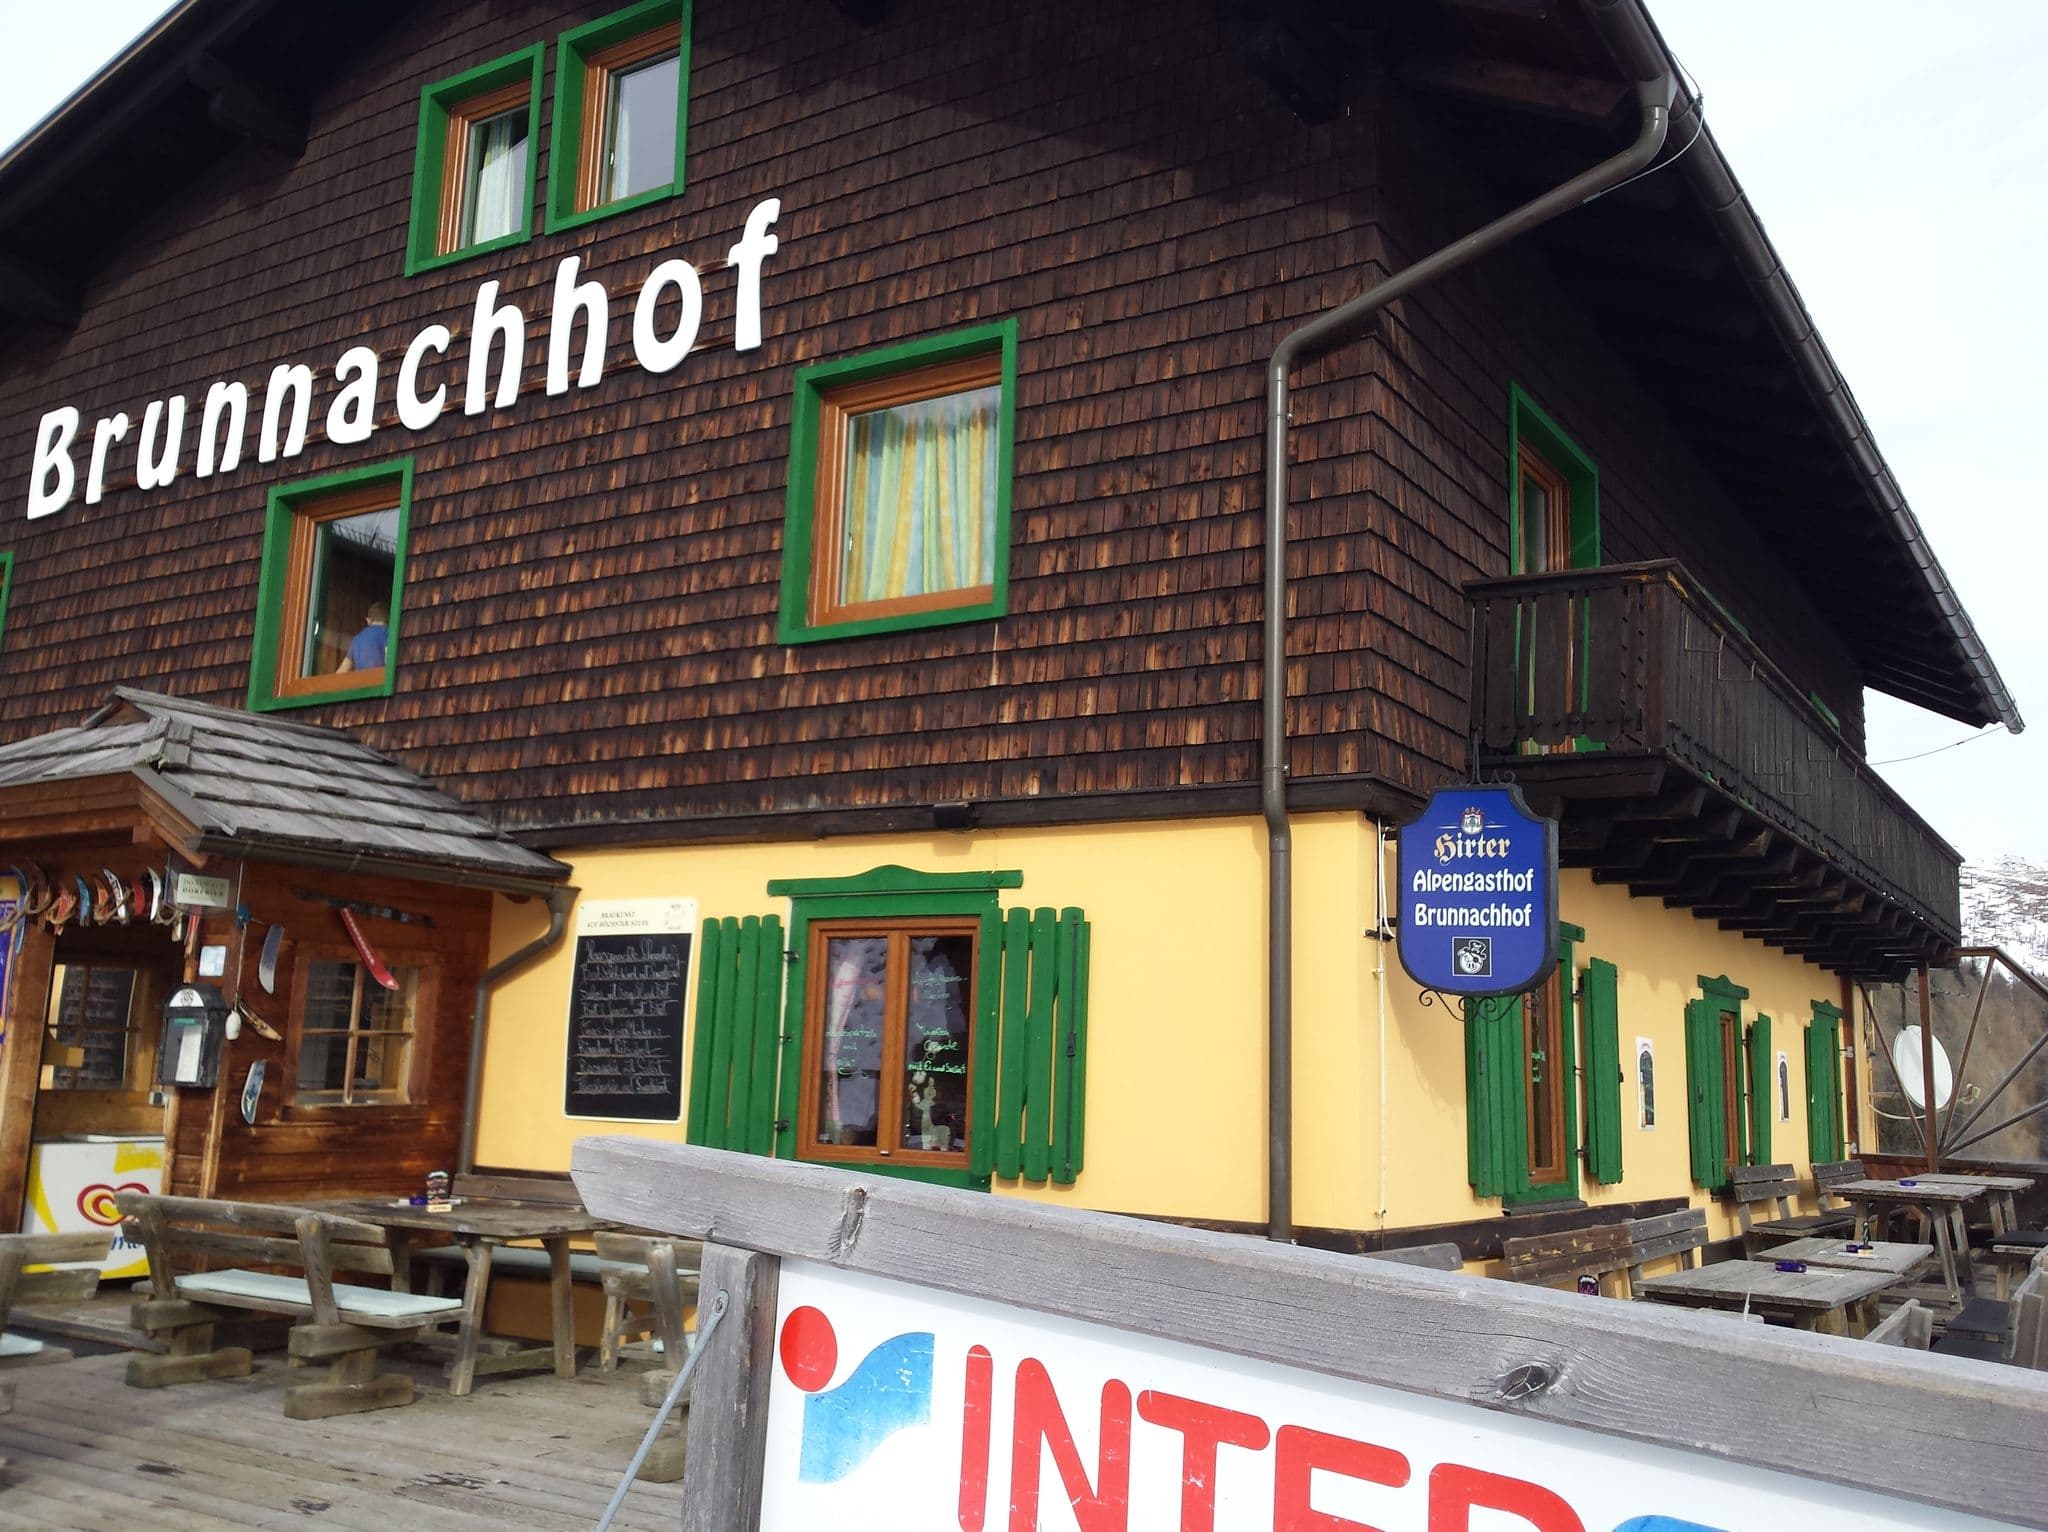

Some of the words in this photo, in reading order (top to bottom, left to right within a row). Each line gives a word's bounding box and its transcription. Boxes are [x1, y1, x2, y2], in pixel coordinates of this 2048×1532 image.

[26, 197, 781, 520] Brunnachhof
[1434, 832, 1511, 866] Hirter
[1413, 868, 1533, 892] Alpengasthof
[1415, 903, 1532, 927] Brunnachhof
